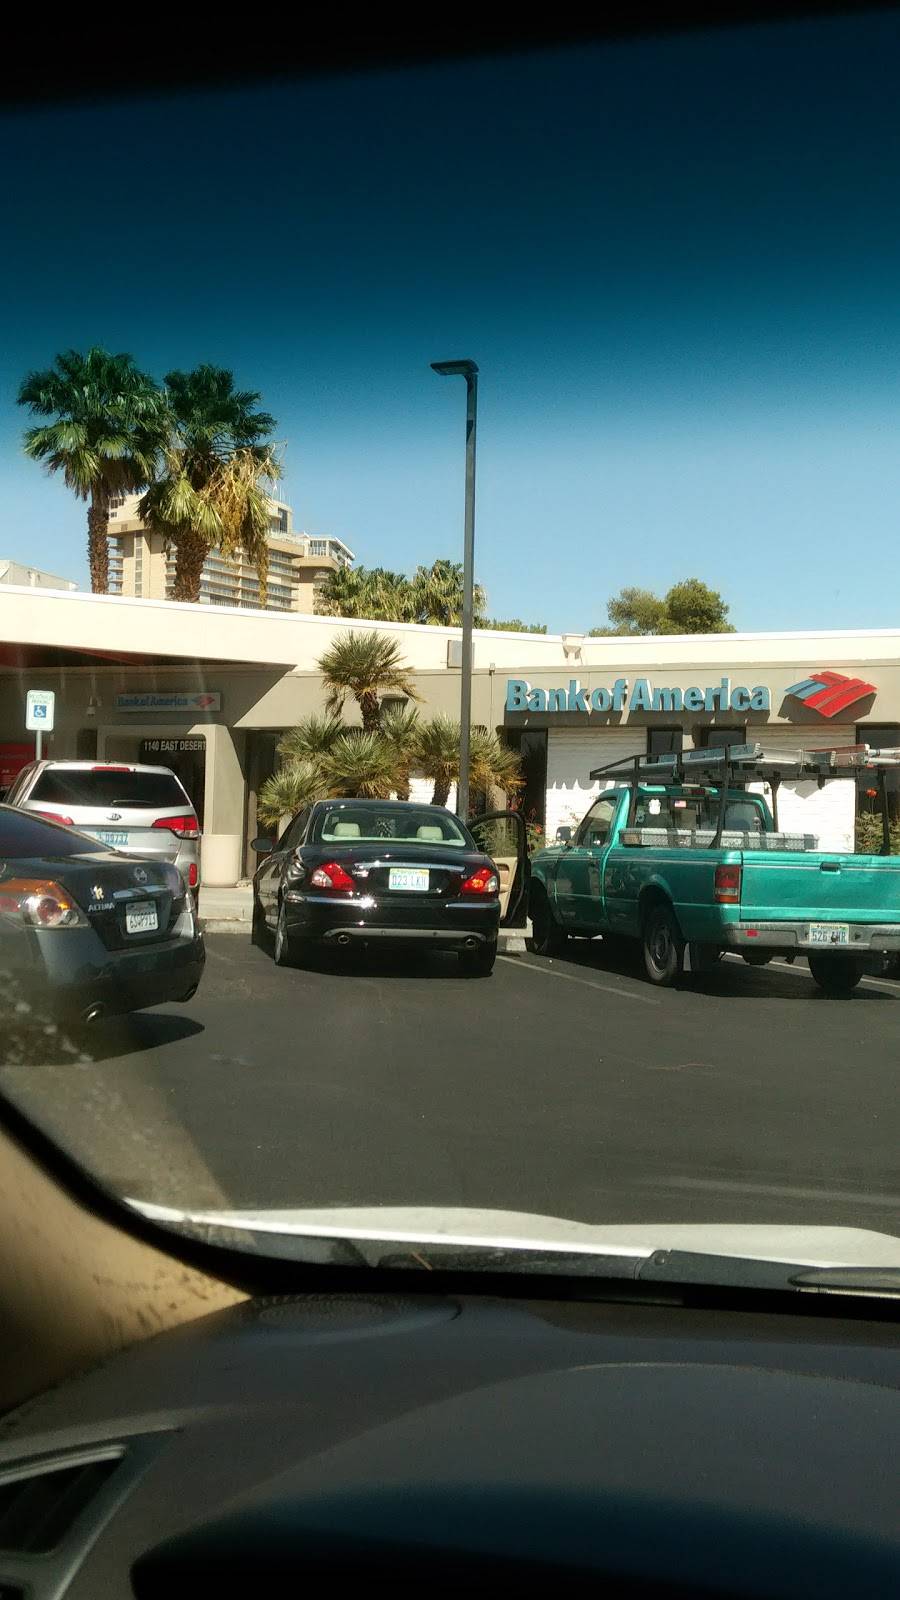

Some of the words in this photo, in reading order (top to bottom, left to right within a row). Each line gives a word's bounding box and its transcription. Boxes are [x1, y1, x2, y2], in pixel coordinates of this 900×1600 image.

[507, 679, 588, 712] Bank
[590, 679, 627, 711] of
[629, 678, 771, 712] America
[144, 741, 160, 751] 1140
[161, 741, 179, 751] EAST
[180, 740, 206, 751] DESERT
